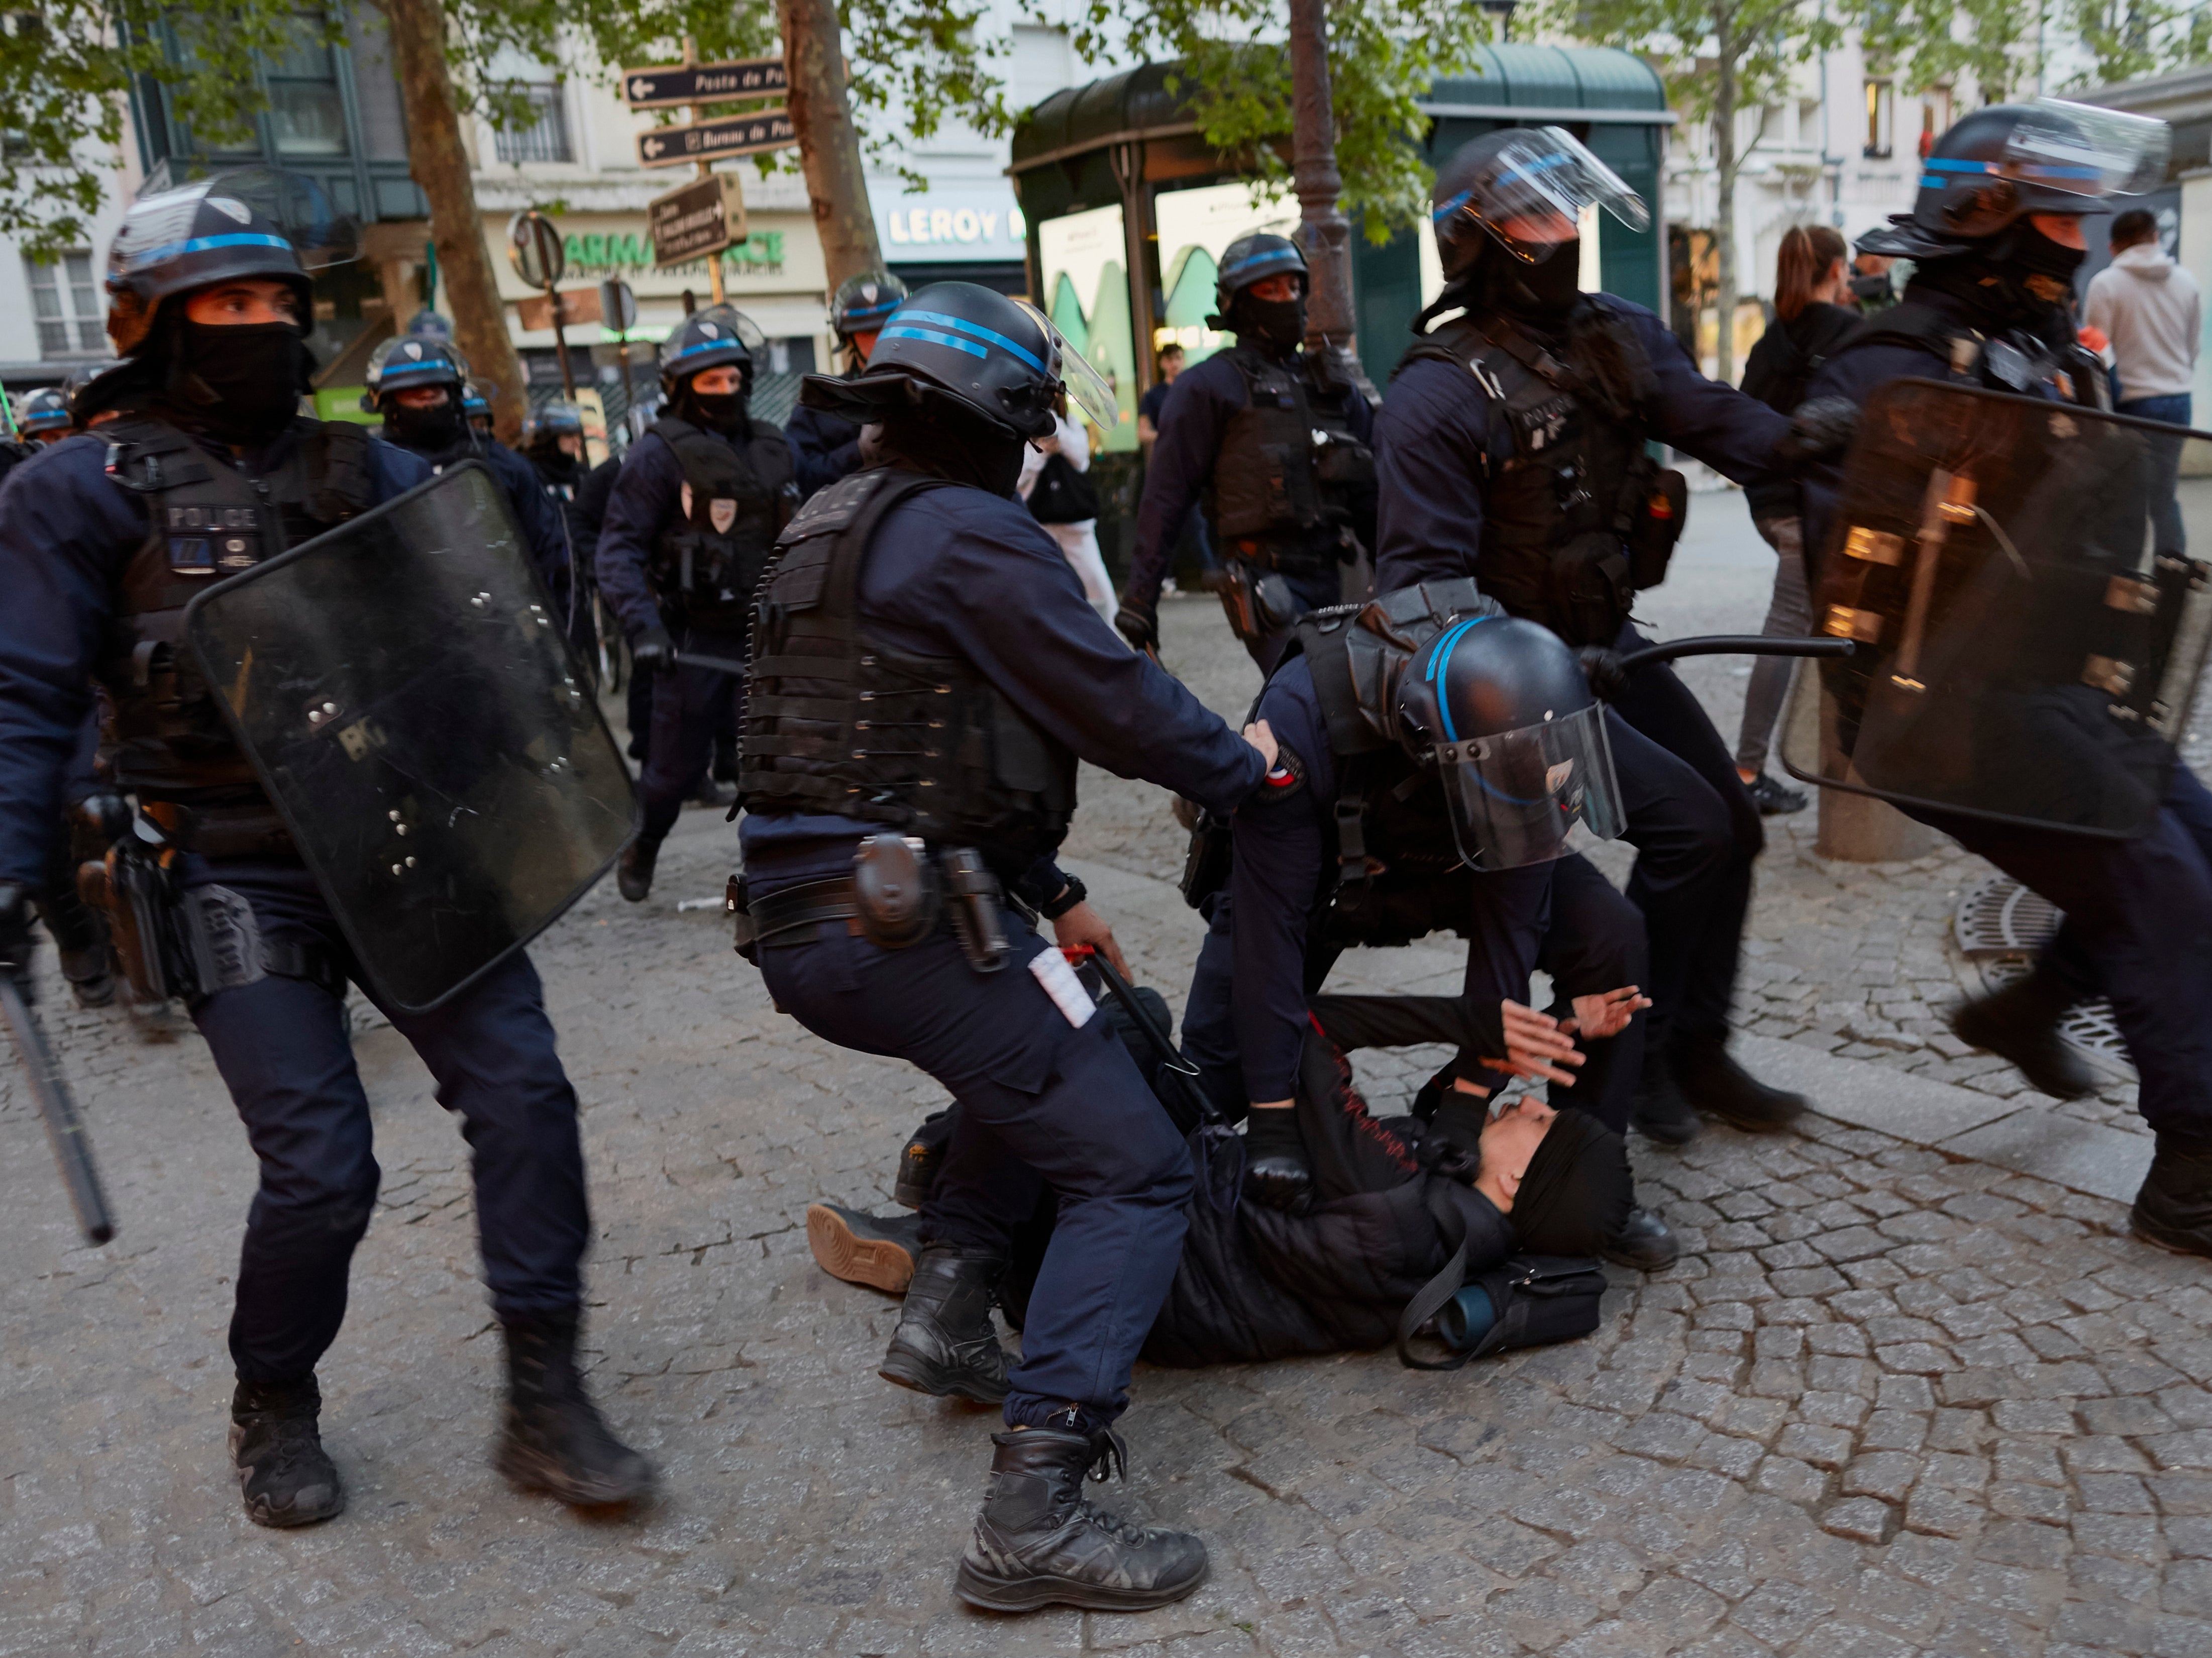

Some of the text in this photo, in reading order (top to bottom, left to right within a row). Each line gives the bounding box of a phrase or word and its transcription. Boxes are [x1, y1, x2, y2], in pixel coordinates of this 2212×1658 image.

[742, 68, 762, 88] de
[702, 129, 745, 149] Bureau
[749, 123, 766, 142] de
[888, 208, 997, 246] LEROY
